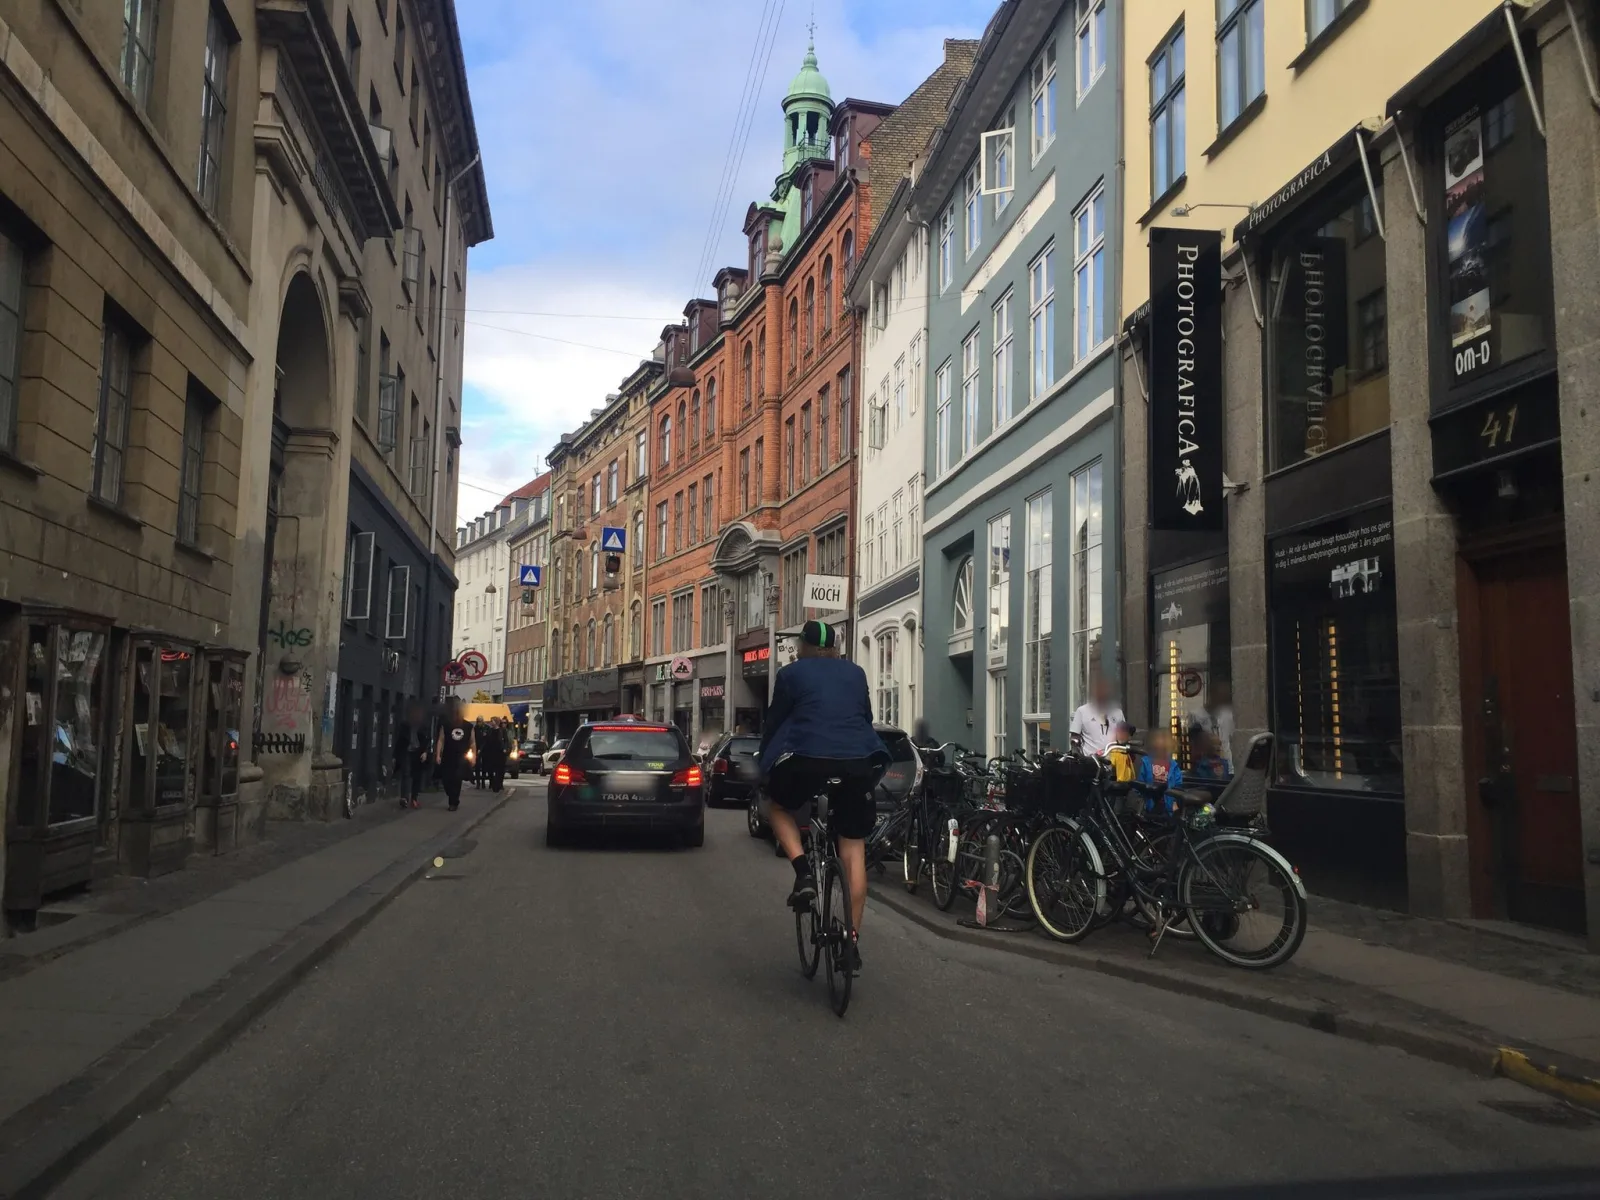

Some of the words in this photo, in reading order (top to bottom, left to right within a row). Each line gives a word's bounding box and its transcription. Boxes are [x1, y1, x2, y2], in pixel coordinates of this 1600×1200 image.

[1248, 150, 1332, 230] PHOTOGRAFICA
[1177, 244, 1200, 457] PHOTOGRAFICA
[1455, 340, 1490, 375] OM-D
[1480, 403, 1518, 448] 41
[811, 587, 841, 602] KOCH
